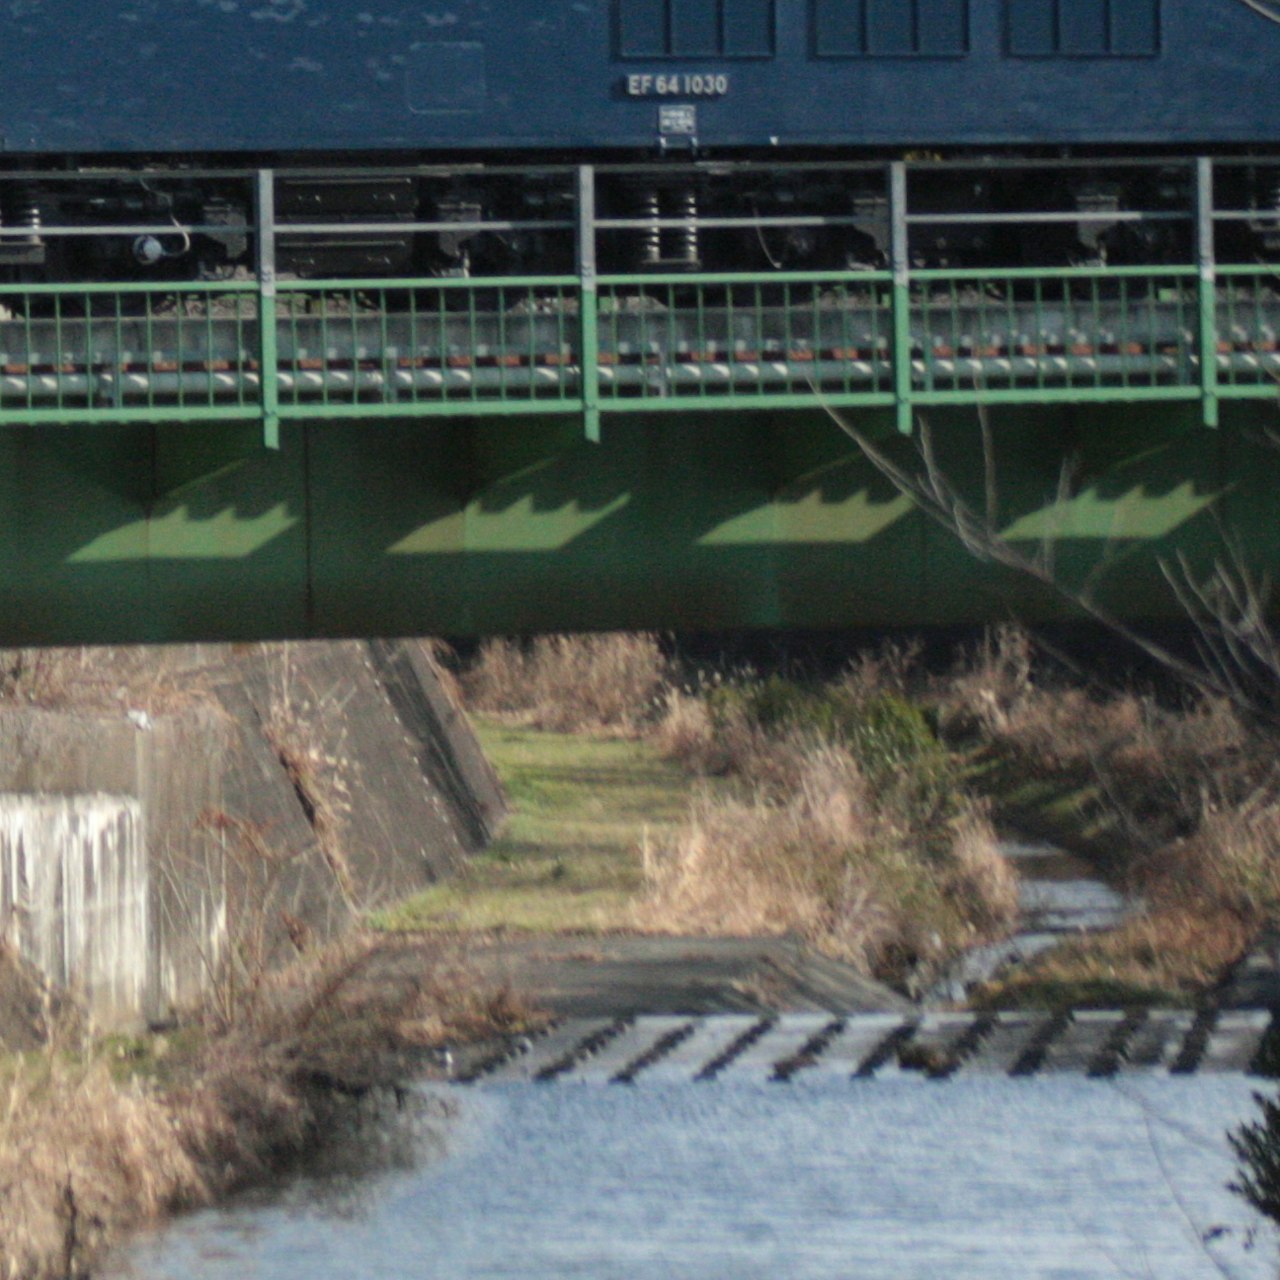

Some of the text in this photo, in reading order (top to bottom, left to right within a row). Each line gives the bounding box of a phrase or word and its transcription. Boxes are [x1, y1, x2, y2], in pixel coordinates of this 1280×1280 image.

[627, 74, 728, 95] EF 64 1030
